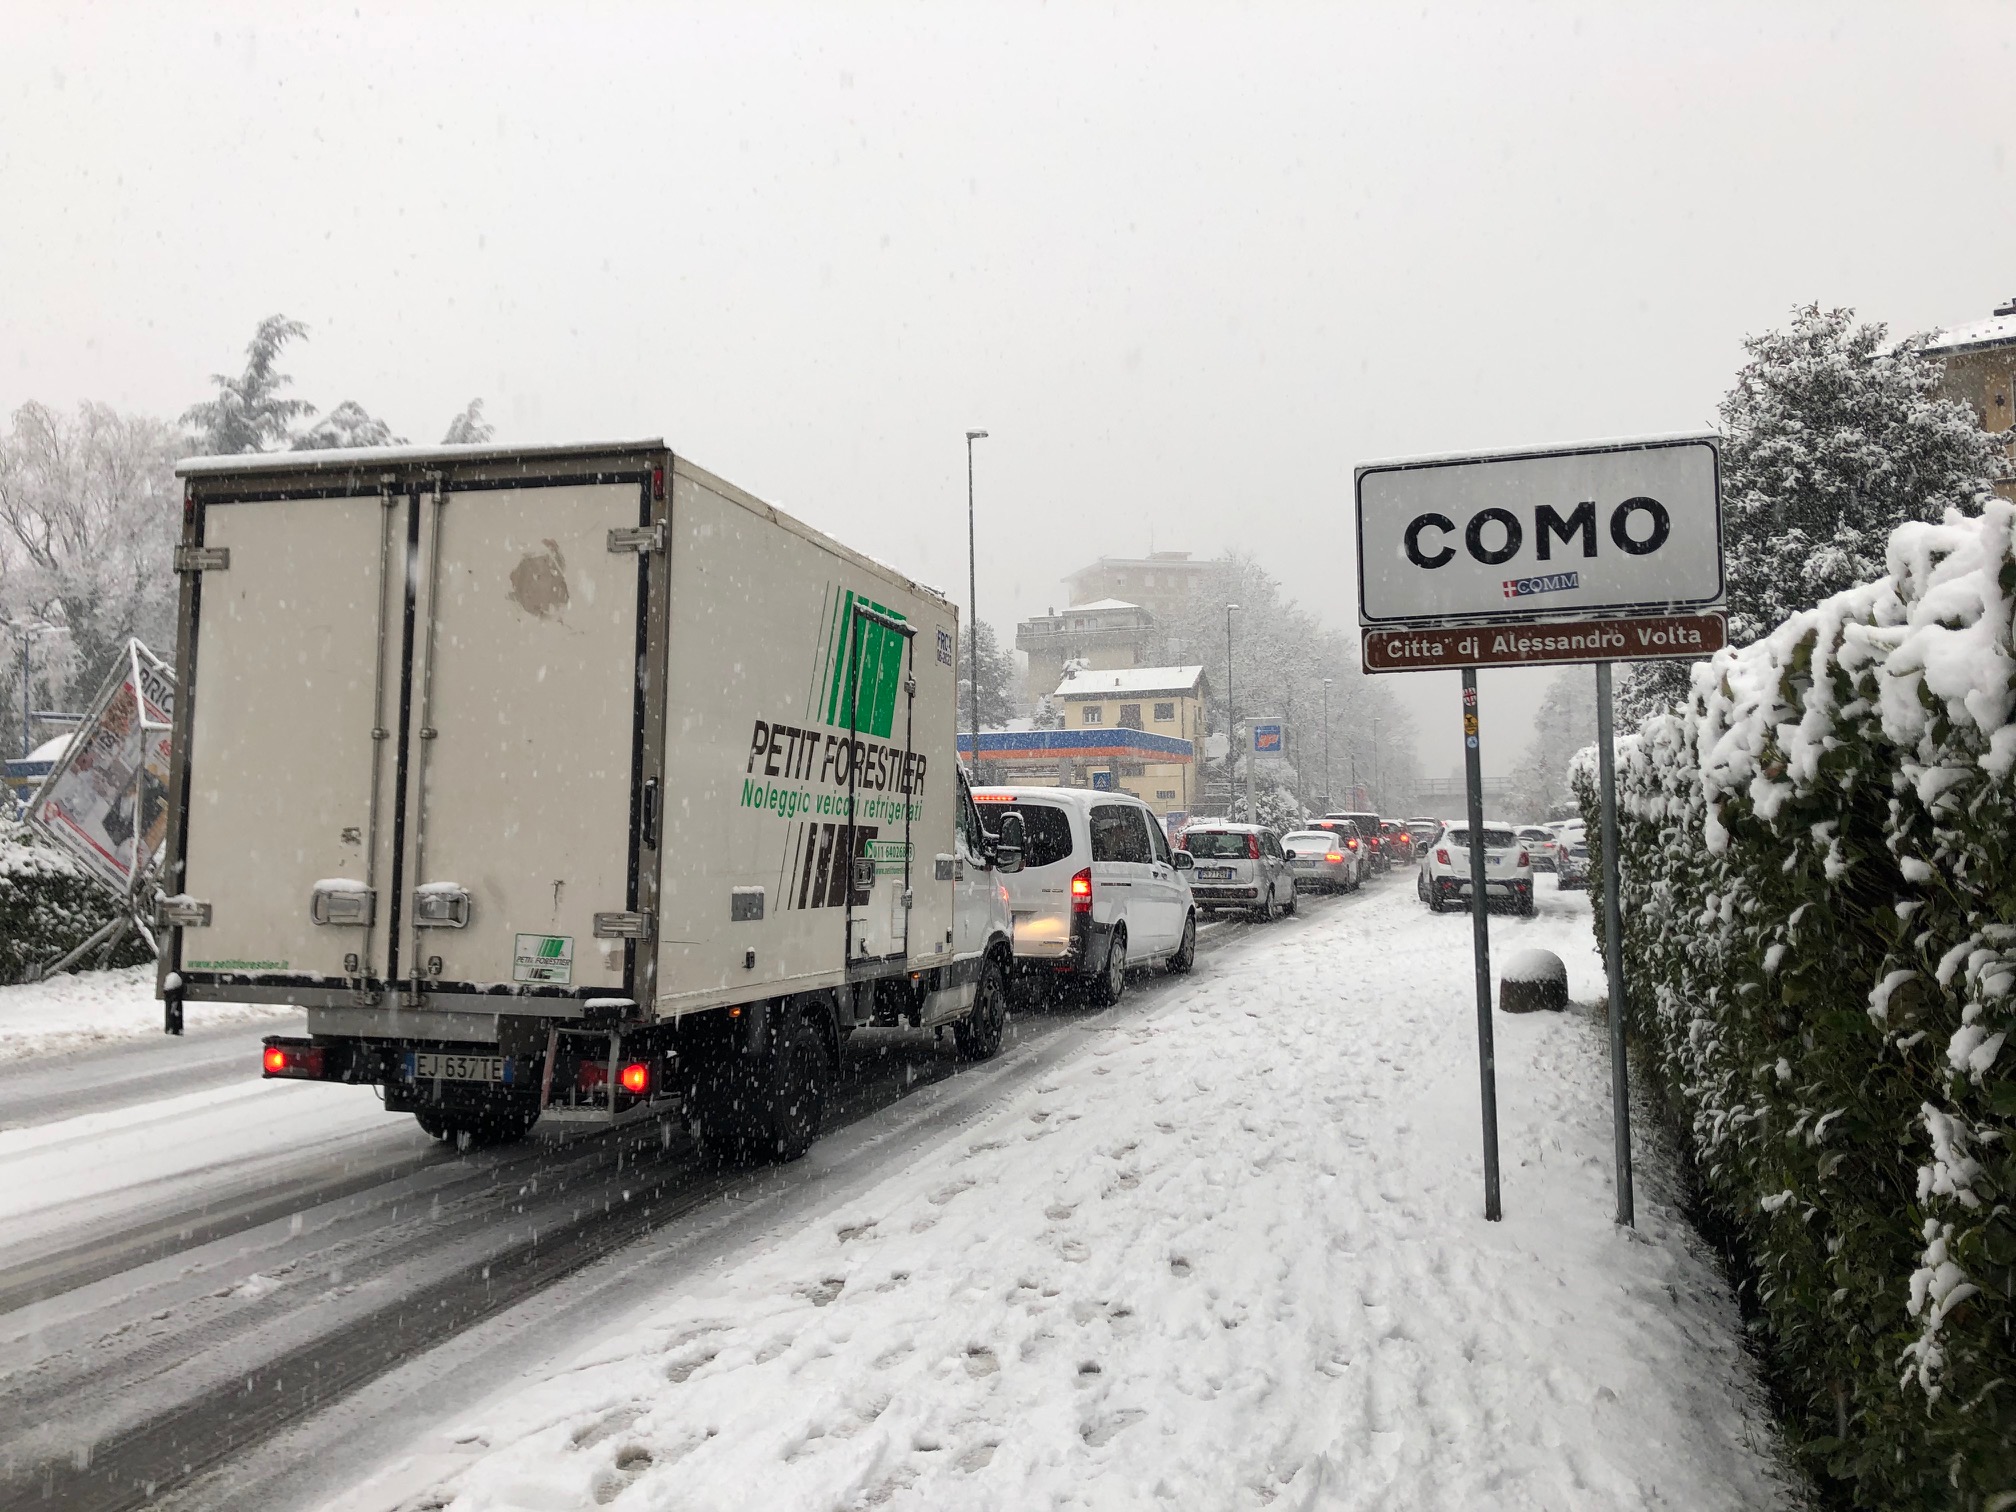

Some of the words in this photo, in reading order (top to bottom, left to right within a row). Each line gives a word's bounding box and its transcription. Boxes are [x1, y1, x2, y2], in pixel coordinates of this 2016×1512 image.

[1404, 496, 1670, 569] COMO
[1517, 573, 1578, 594] COMM
[1458, 636, 1479, 657] di
[1492, 629, 1626, 653] Alessandro
[1637, 626, 1701, 646] Volta
[747, 720, 821, 780] PETIT
[820, 734, 926, 796] FORESTIER
[740, 778, 810, 819] Noleggio
[816, 789, 861, 816] veicoi
[417, 1055, 438, 1077] EJ
[446, 1057, 503, 1080] 637TE
